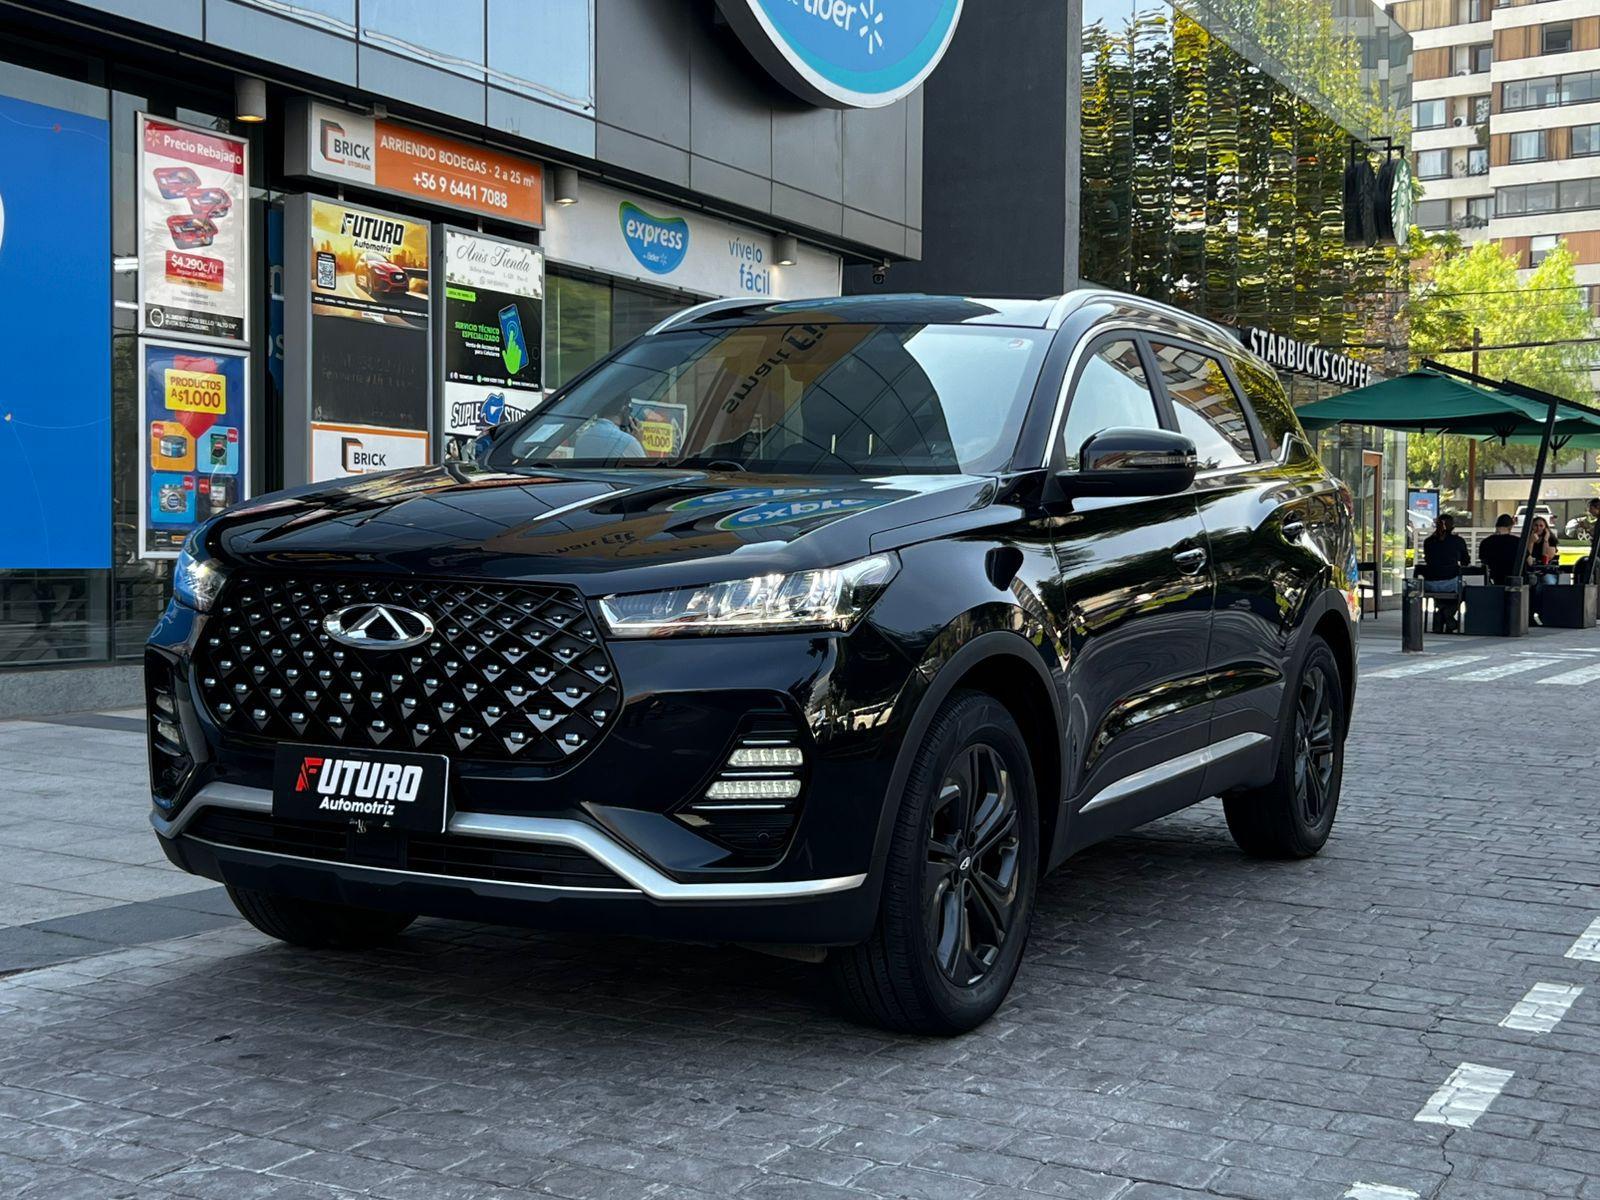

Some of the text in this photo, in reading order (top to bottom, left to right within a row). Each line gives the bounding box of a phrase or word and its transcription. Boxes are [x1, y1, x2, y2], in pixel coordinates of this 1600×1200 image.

[164, 134, 242, 164] Precio Rebajado
[334, 138, 370, 160] BRICK
[380, 136, 436, 160] ARRIENDO
[438, 150, 487, 174] BODEGAS
[494, 166, 500, 178] 2
[502, 171, 508, 180] a
[510, 170, 520, 184] 25
[412, 171, 508, 208] +56 9 6441 7088
[340, 212, 404, 246] FUTURO
[626, 218, 683, 250] express
[354, 240, 392, 254] Automotriz
[456, 240, 530, 272] Anis Tienda
[728, 236, 762, 264] vívelo
[738, 264, 770, 295] fácil
[1250, 327, 1329, 379] STARBUCKS
[170, 376, 222, 390] PRODUCTOS
[171, 388, 220, 408] A $1.000
[452, 401, 481, 428] SUPLE
[354, 452, 386, 466] BRICK
[295, 757, 424, 802] FUTURO
[319, 796, 396, 816] Automotriz
